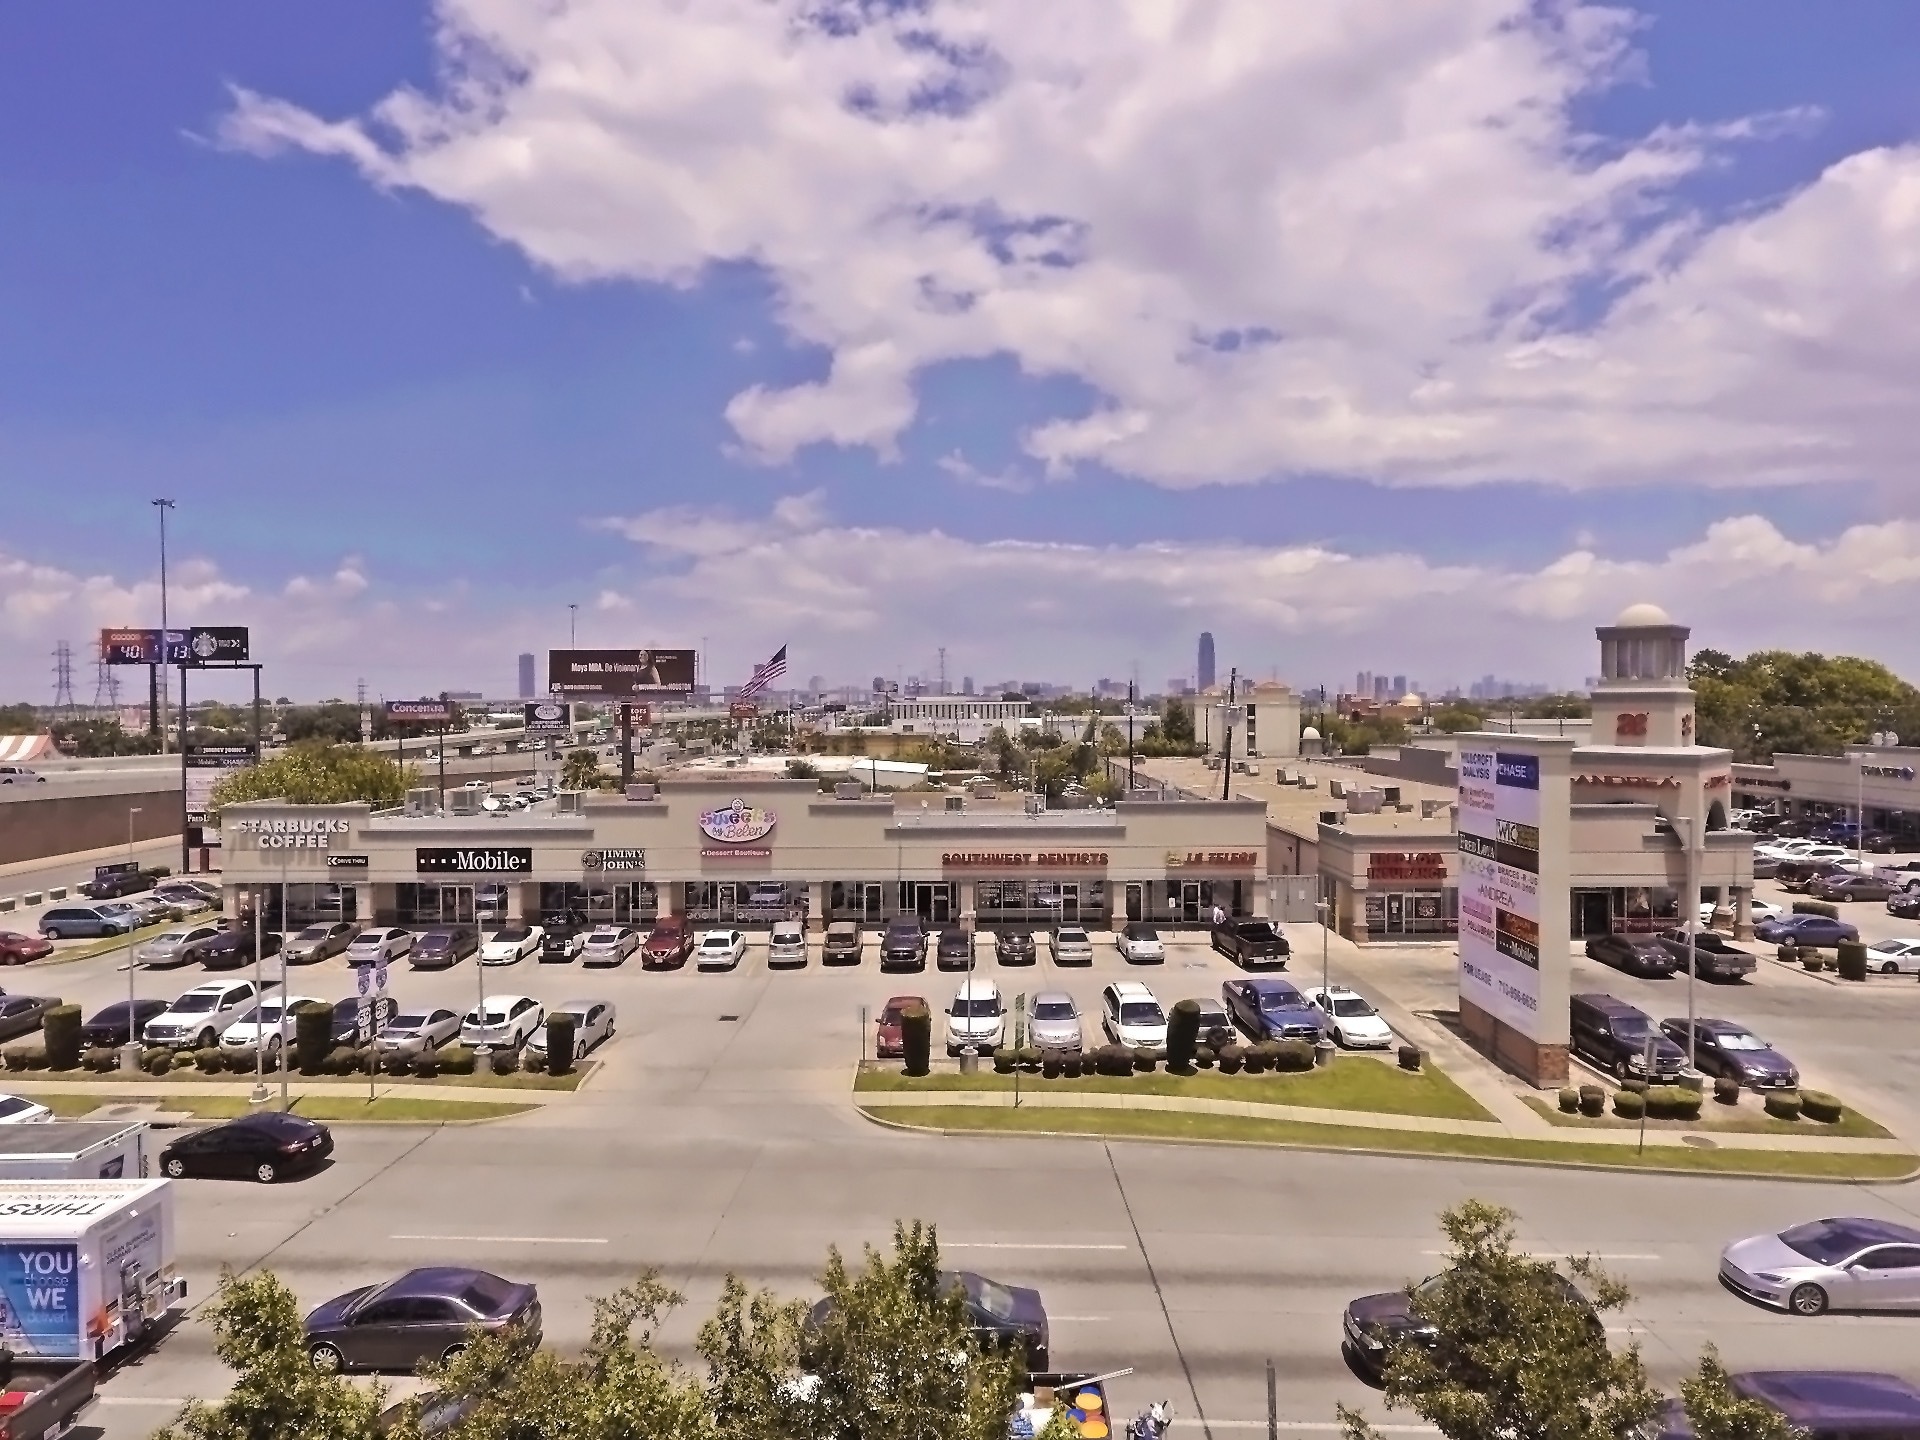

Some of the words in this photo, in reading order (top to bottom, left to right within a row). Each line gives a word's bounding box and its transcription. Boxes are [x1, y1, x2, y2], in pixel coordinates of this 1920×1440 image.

[1499, 763, 1527, 778] CHASE
[239, 818, 350, 834] STARBUCKS
[258, 835, 329, 849] COFFEE
[602, 850, 645, 861] JIMMY
[706, 849, 734, 857] Dessert
[941, 852, 1032, 866] SOUTHWEST
[1037, 852, 1109, 866] DENTISTS
[456, 851, 520, 871] Mobile
[602, 861, 646, 872] JOHN'S
[359, 1010, 370, 1024] 59
[377, 1003, 387, 1017] 59
[18, 1251, 73, 1275] YOU
[24, 1273, 70, 1288] choose
[26, 1287, 67, 1311] WE
